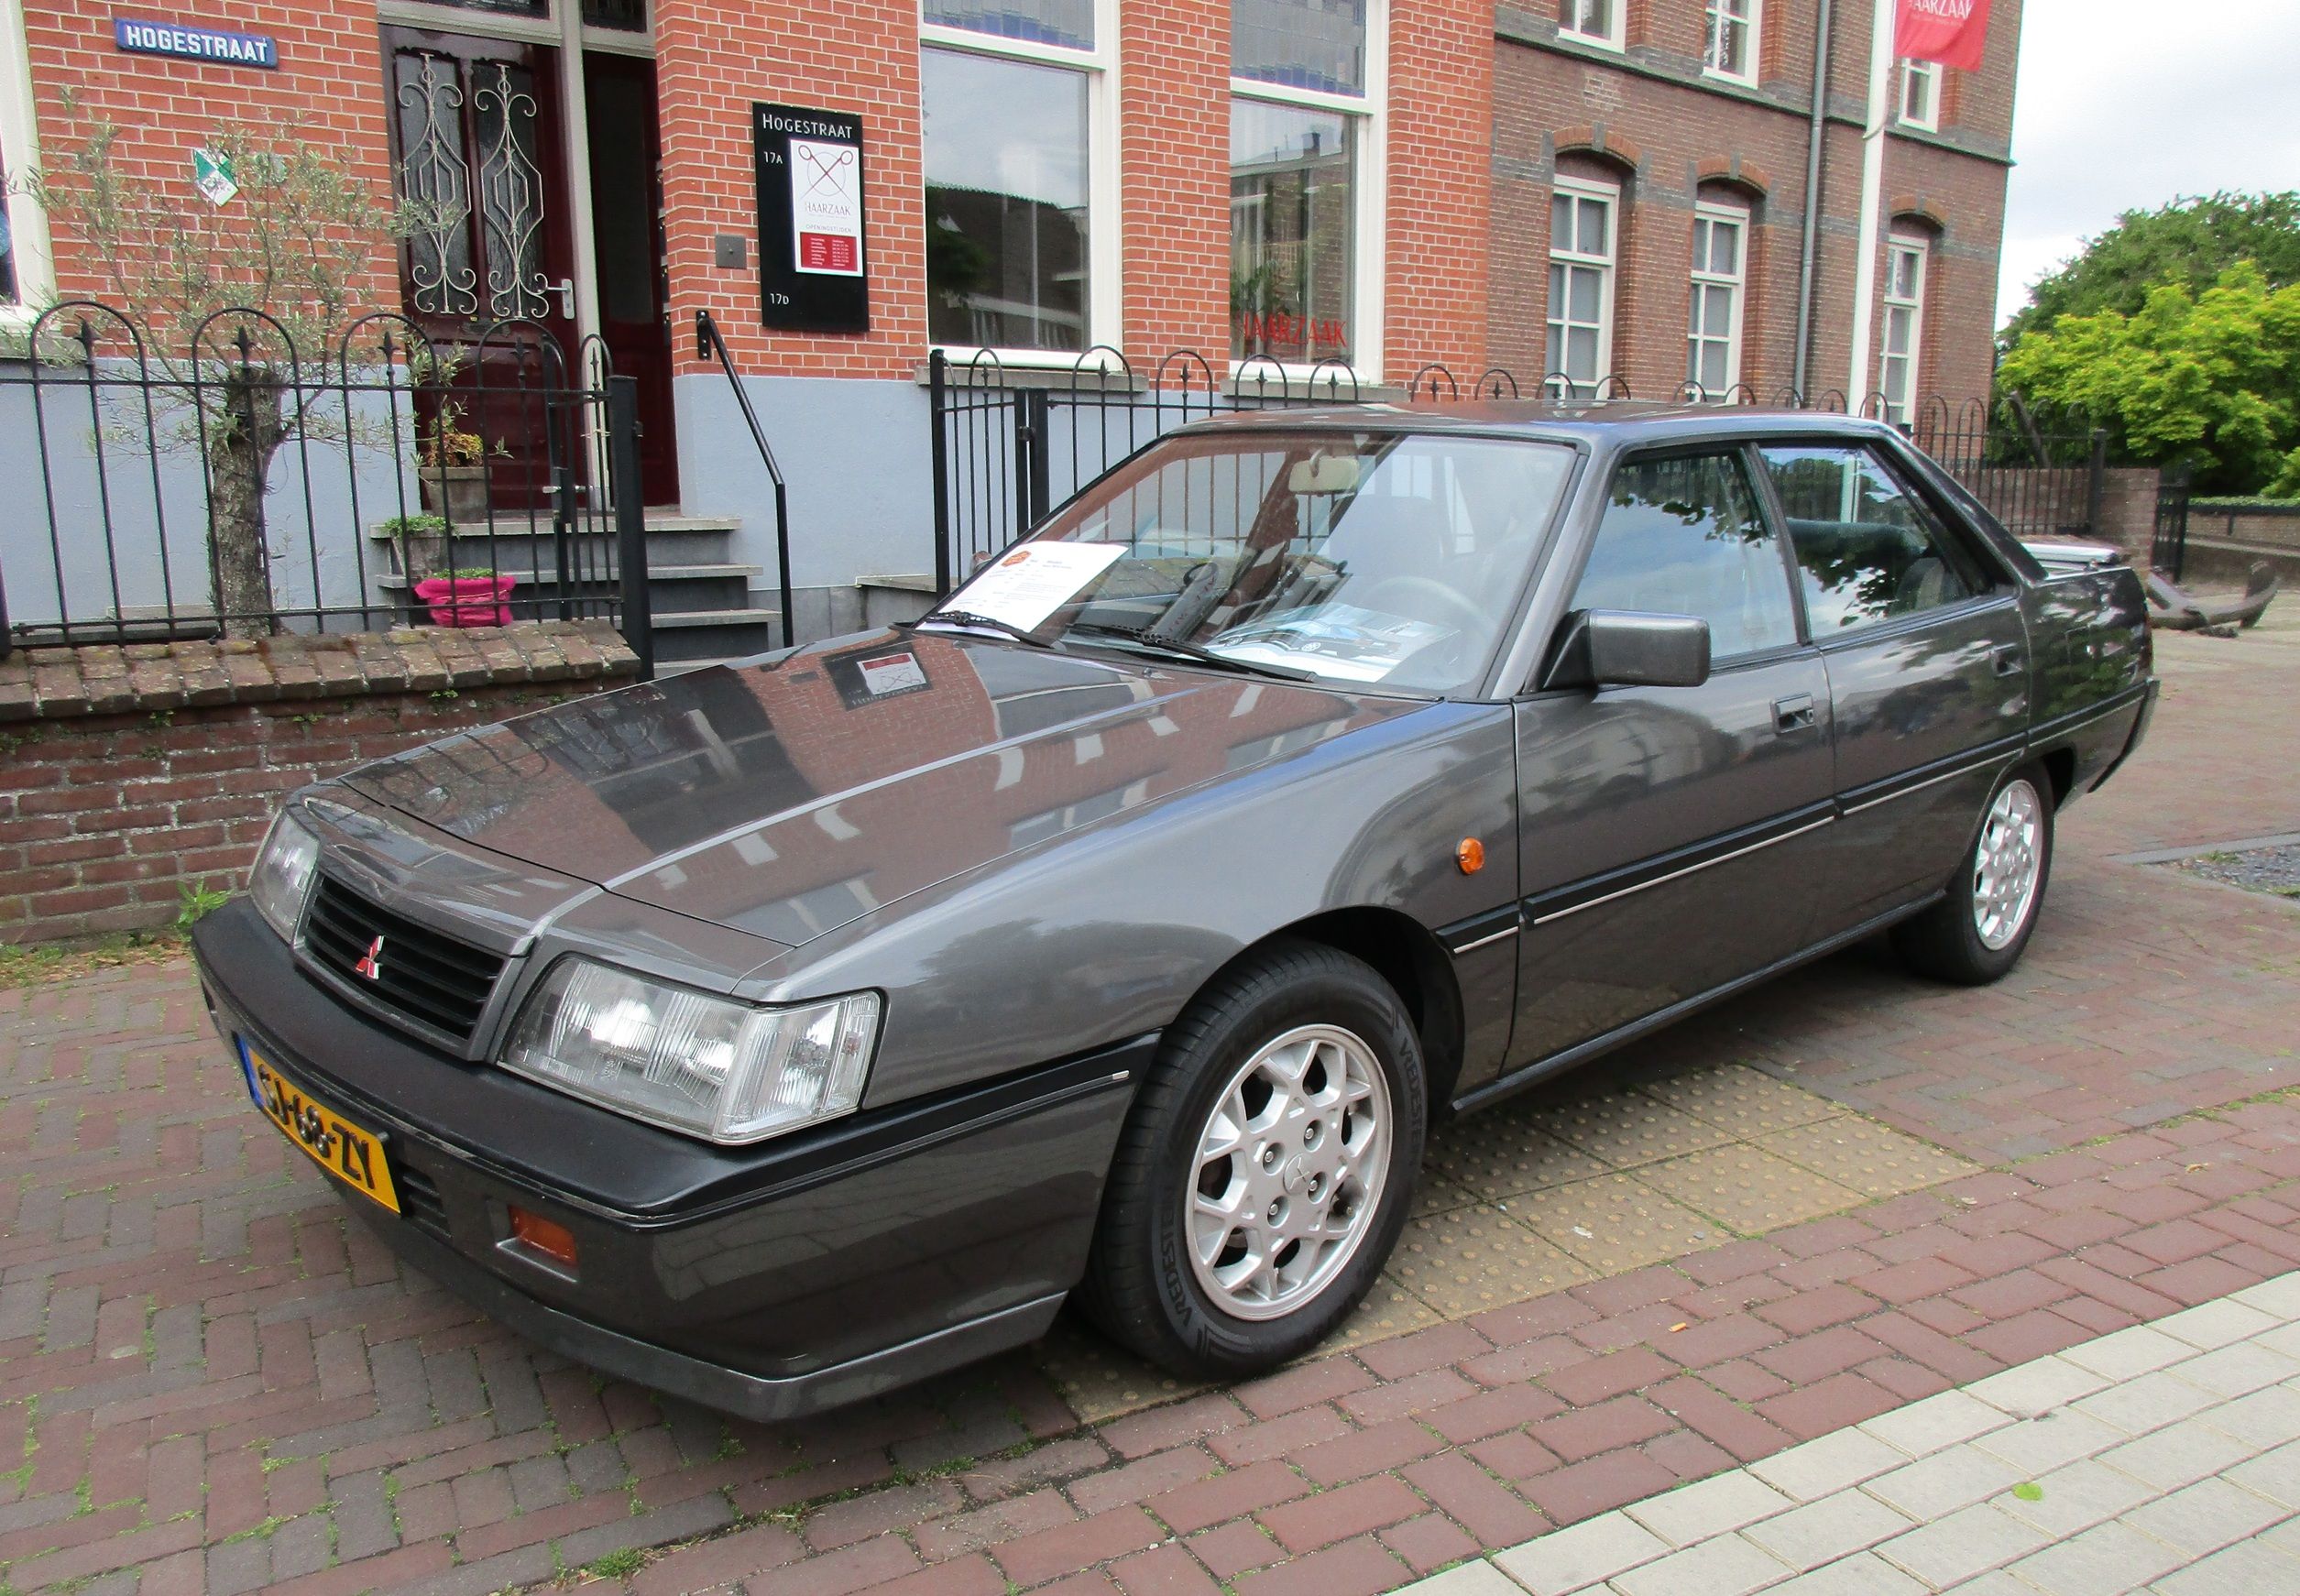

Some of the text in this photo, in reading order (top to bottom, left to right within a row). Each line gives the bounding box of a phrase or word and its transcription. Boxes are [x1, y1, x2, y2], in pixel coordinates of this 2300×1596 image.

[126, 25, 268, 62] HOGESTRAAT
[762, 113, 852, 139] HOGESTRAAT
[763, 150, 783, 165] 17A
[805, 201, 851, 216] HAARZAAK
[770, 292, 790, 306] 17D
